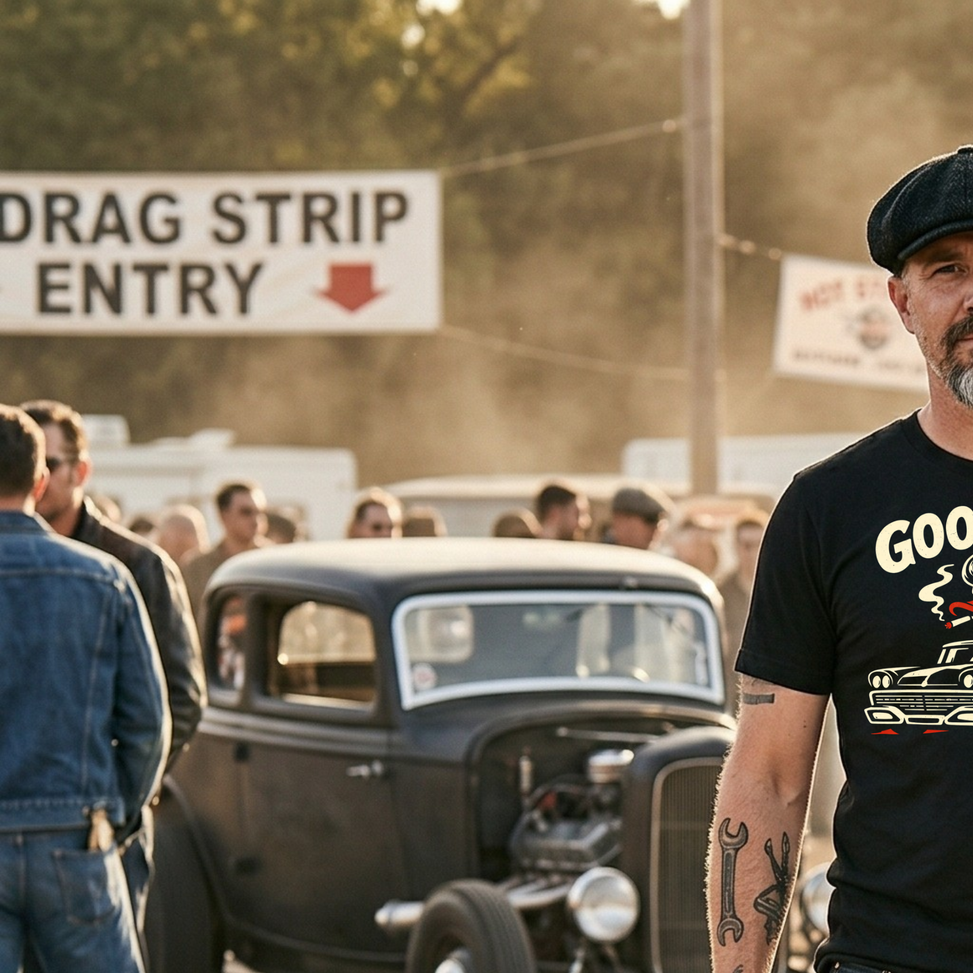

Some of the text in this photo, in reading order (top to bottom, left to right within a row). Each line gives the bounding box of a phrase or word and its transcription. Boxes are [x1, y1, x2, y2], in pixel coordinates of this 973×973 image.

[0, 191, 409, 245] DRAG STRIP
[36, 262, 264, 317] ENTRY
